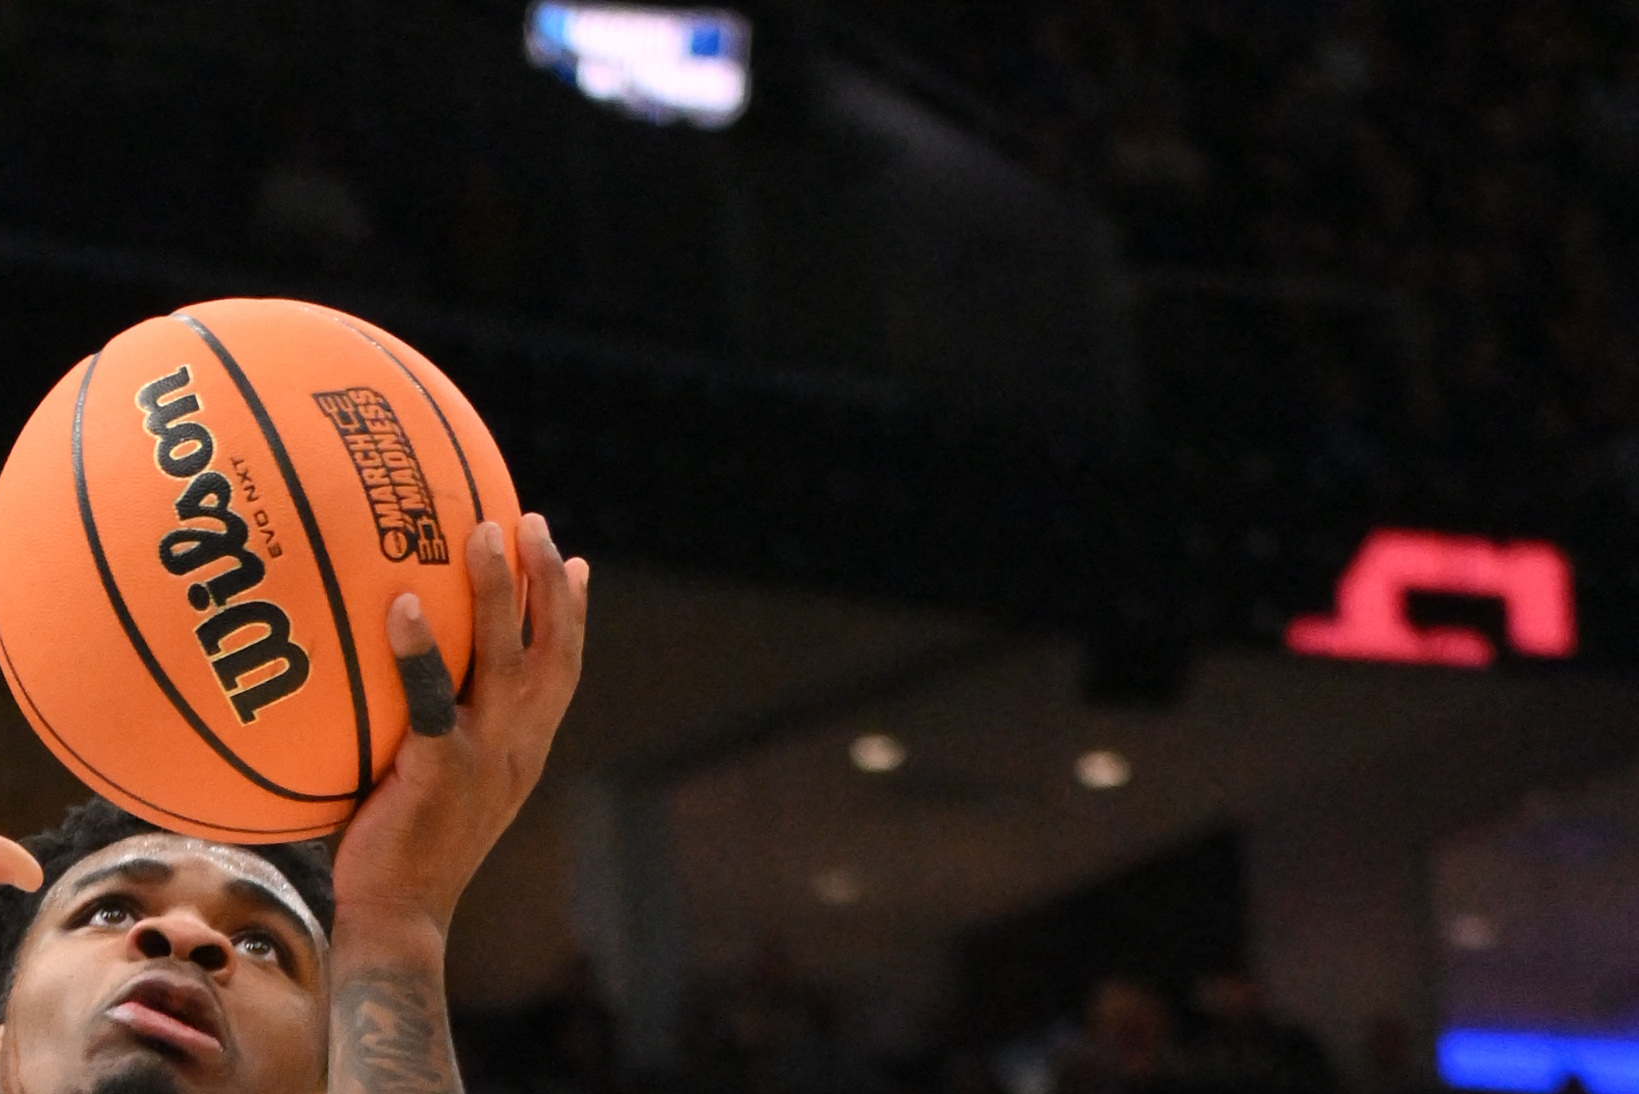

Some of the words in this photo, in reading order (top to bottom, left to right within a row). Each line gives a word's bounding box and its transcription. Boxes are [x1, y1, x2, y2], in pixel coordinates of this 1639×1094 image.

[229, 456, 259, 503] NXT
[344, 433, 406, 530] MARCH
[347, 388, 428, 513] MADNESS
[135, 365, 310, 727] Wilson
[253, 509, 283, 559] EVO
